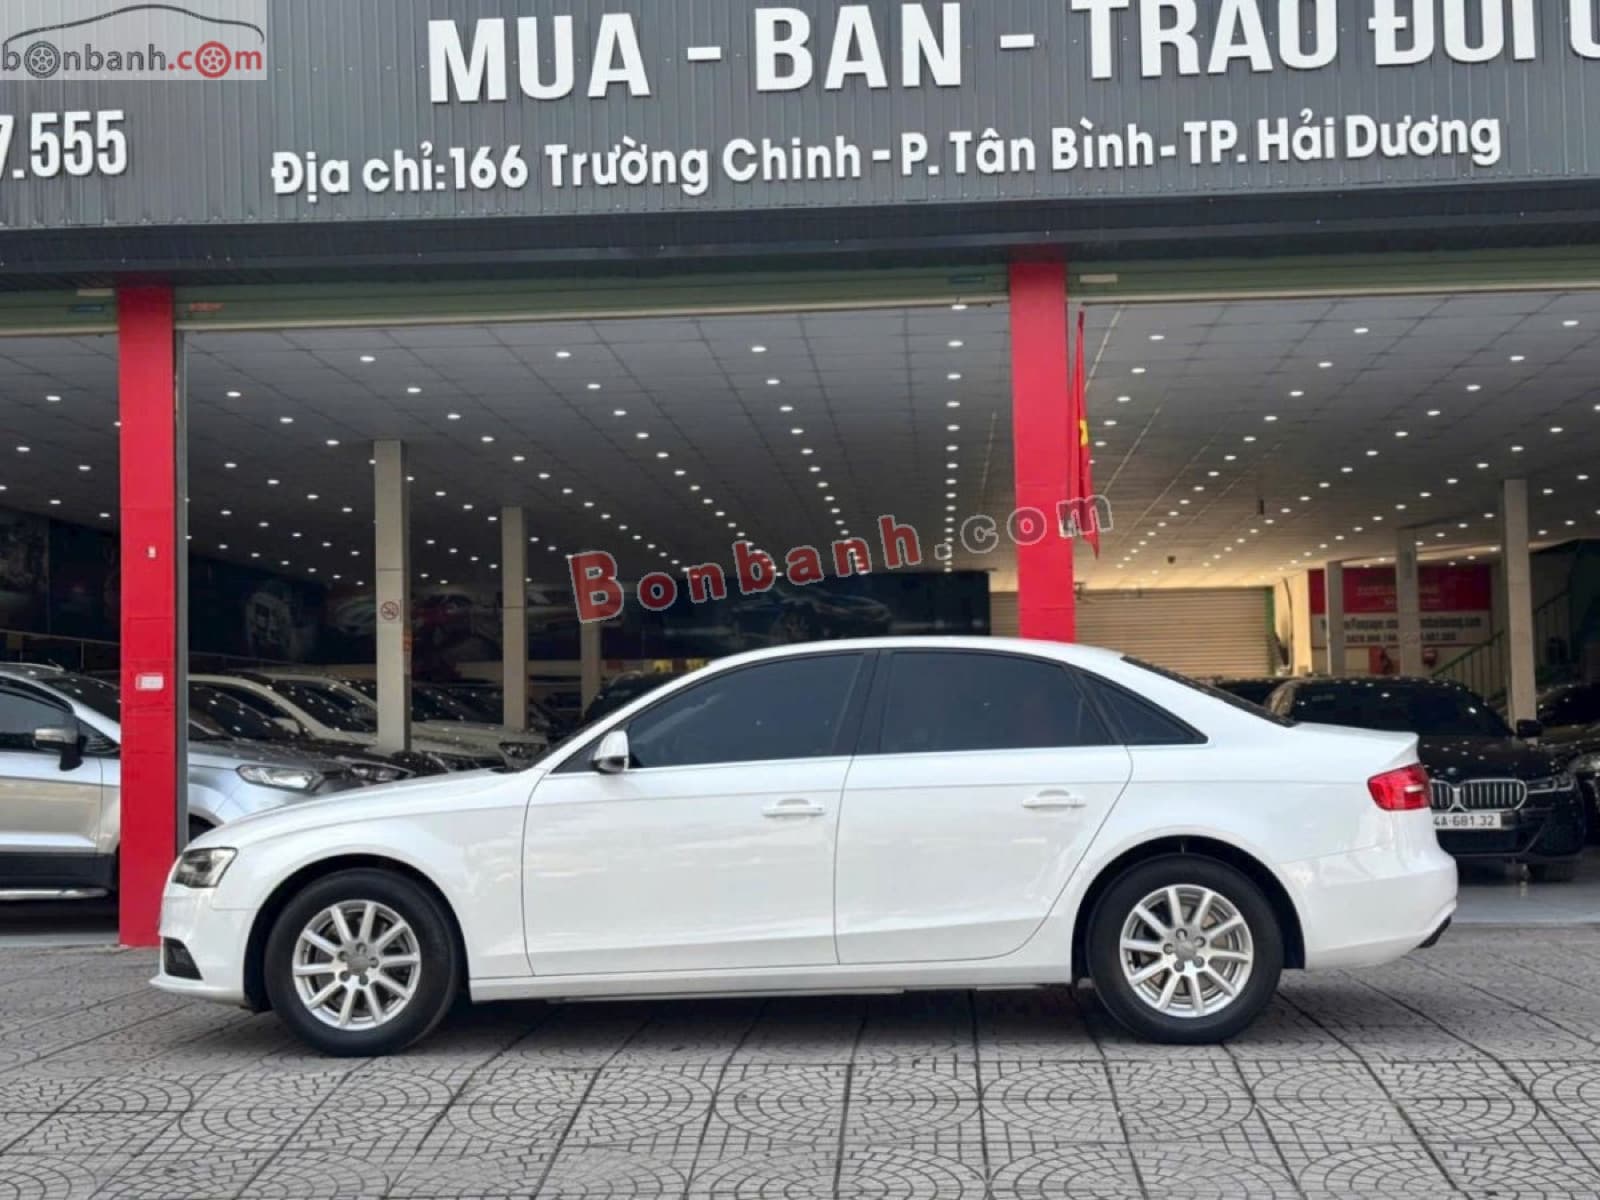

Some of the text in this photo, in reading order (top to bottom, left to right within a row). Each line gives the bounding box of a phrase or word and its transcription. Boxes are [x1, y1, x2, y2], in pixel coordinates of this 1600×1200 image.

[429, 14, 649, 101] MUA
[688, 47, 720, 59] -
[1000, 35, 1034, 48] -
[272, 152, 348, 202] Địa
[546, 136, 708, 195] Trường
[723, 136, 860, 180] Chinh
[902, 133, 938, 174] P.
[950, 128, 1035, 172] Tân
[1259, 109, 1334, 160] Hải
[1347, 115, 1500, 164] Dương
